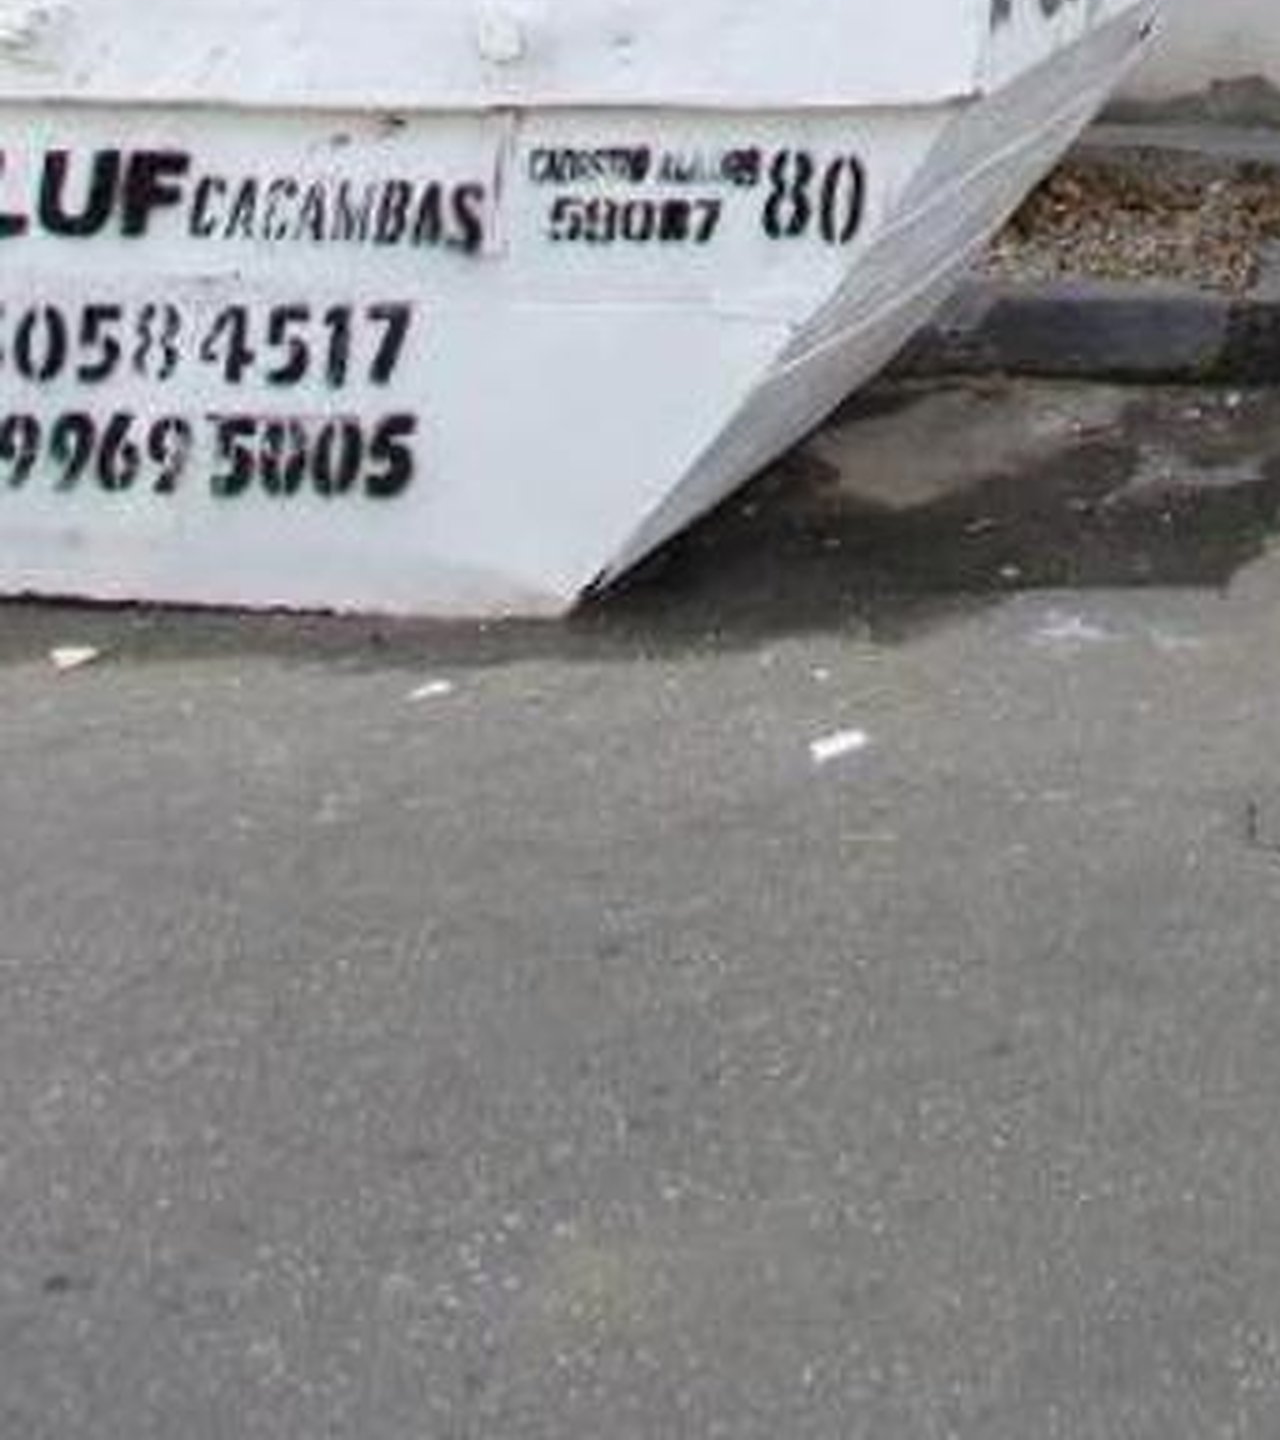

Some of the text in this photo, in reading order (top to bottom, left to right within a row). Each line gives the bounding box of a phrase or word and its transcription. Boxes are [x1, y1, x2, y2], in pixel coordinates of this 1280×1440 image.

[761, 148, 866, 245] 80
[0, 301, 412, 388] 058 4517
